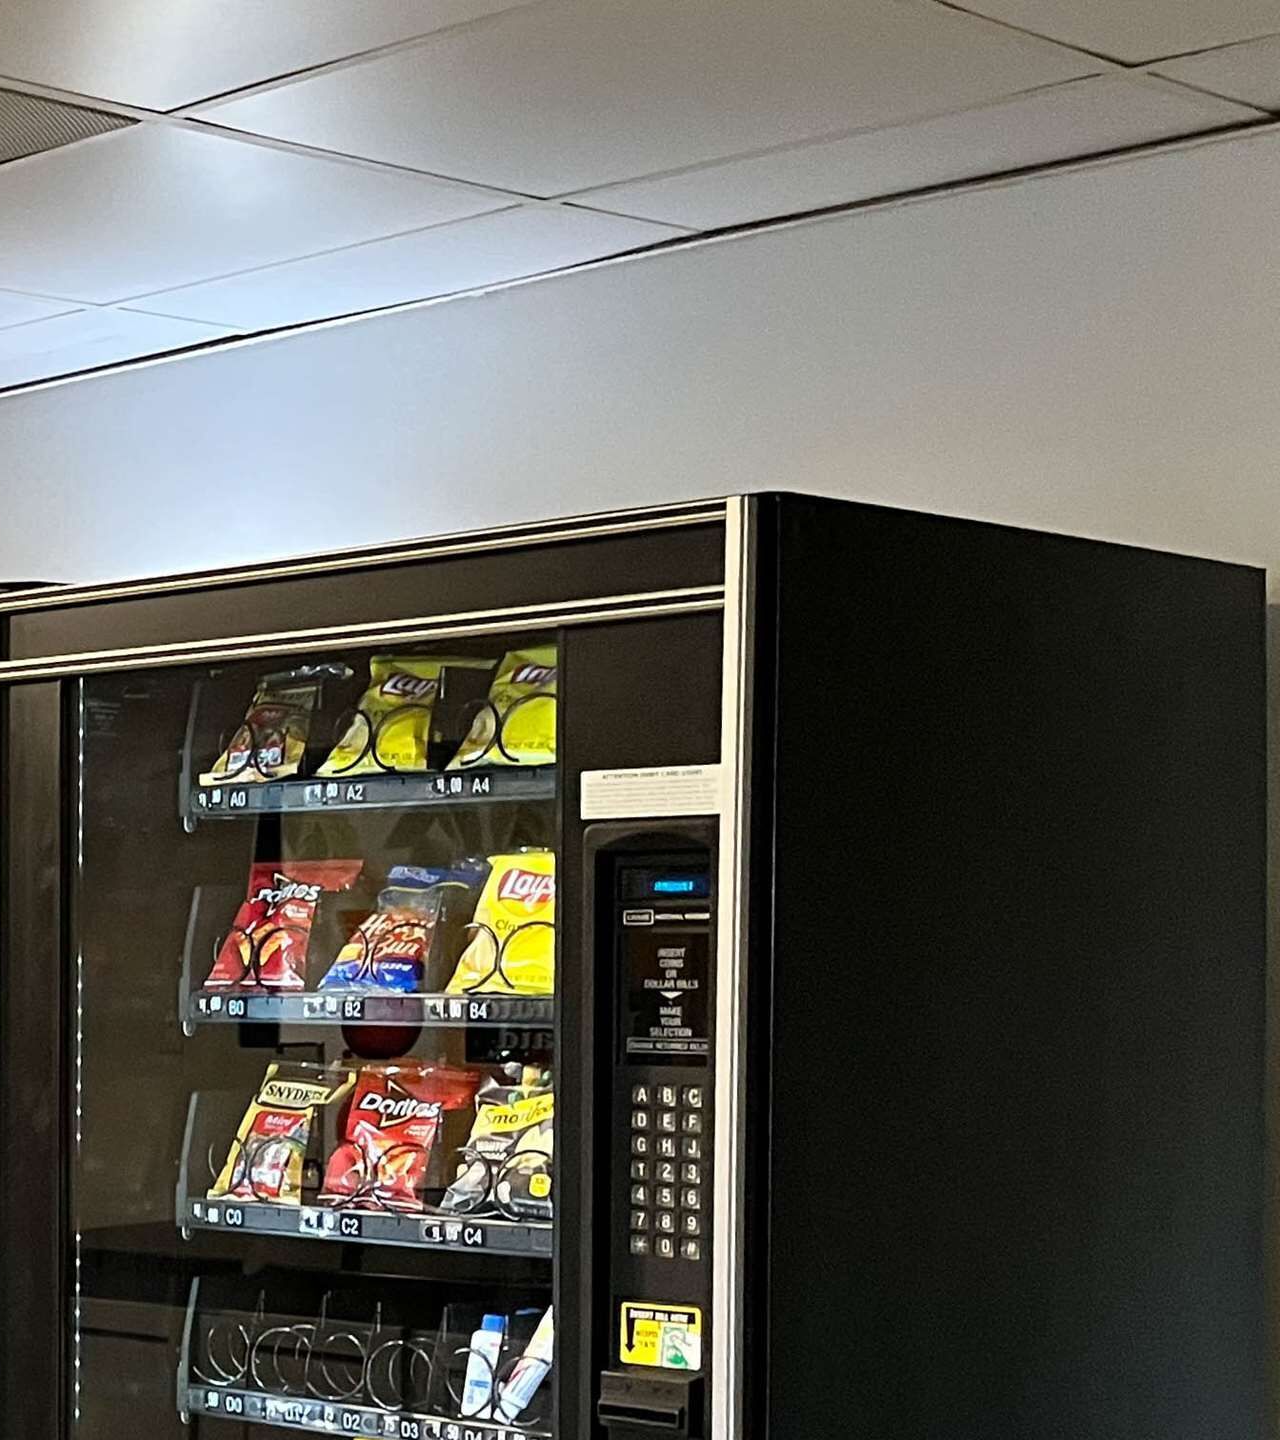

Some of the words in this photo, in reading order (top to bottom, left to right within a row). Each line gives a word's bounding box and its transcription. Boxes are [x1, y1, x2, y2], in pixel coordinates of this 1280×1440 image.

[346, 784, 363, 800] A2
[472, 777, 490, 793] A4
[230, 791, 246, 807] A0
[665, 969, 678, 979] OR
[643, 979, 675, 989] DOLLAR
[228, 999, 245, 1016] B0
[344, 1001, 361, 1017] B2
[469, 1002, 488, 1019] B4
[649, 1027, 693, 1037] SELECTION
[637, 1087, 647, 1103] A
[662, 1087, 672, 1103] B
[688, 1088, 698, 1103] C
[360, 1092, 442, 1118] Doritos
[637, 1112, 647, 1127] D
[662, 1113, 671, 1128] E
[688, 1114, 697, 1129] F
[637, 1137, 646, 1152] G
[662, 1138, 672, 1153] H
[688, 1139, 697, 1154] J
[638, 1163, 645, 1177] 1
[662, 1164, 671, 1178] 2
[687, 1164, 696, 1180] 3
[636, 1187, 645, 1201] 4
[662, 1188, 671, 1202] 5
[687, 1190, 696, 1205] 6
[226, 1208, 242, 1225] C0
[637, 1212, 645, 1226] 7
[661, 1214, 670, 1228] 8
[687, 1216, 696, 1230] 9
[341, 1218, 359, 1235] C2
[464, 1228, 482, 1245] C4
[661, 1239, 670, 1253] 0
